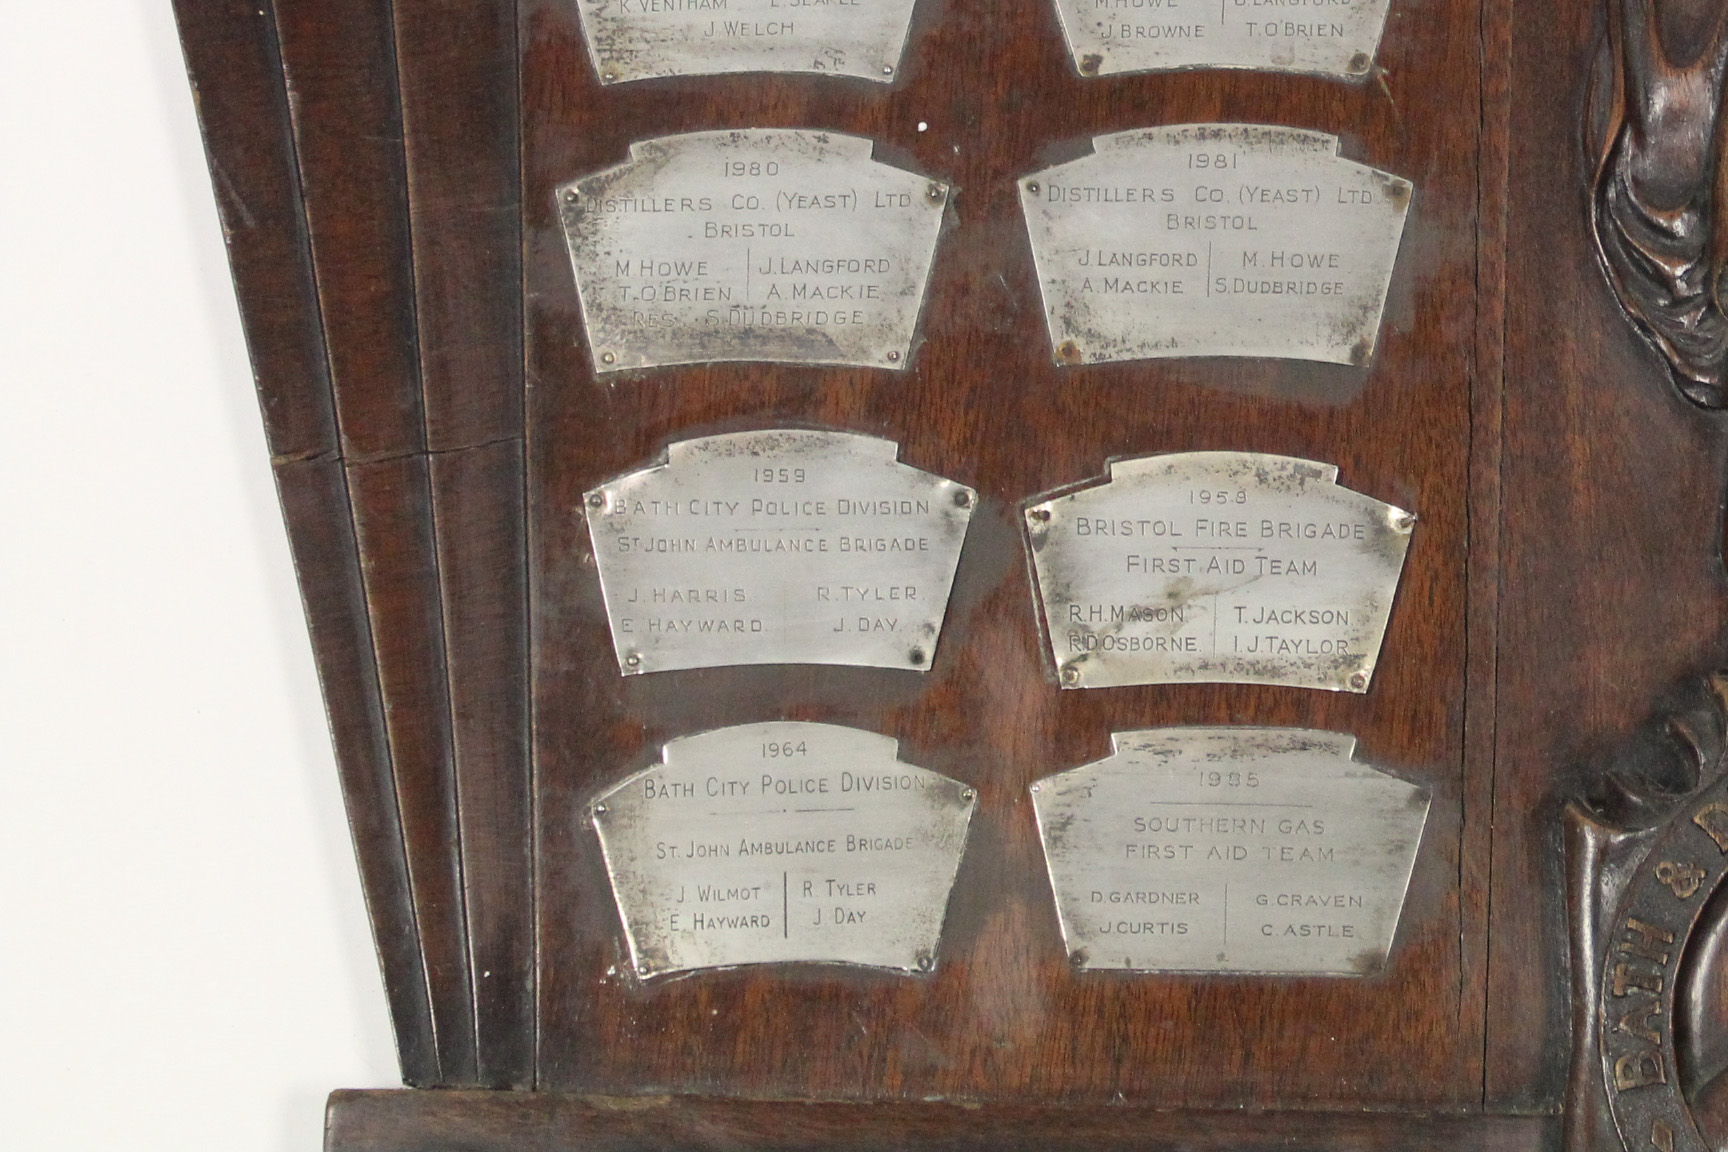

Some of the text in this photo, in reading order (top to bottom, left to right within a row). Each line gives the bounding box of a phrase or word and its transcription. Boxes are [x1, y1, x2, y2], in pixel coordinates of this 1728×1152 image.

[725, 161, 779, 178] 1980
[1188, 154, 1238, 169] 1981
[1048, 186, 1175, 203] DISTILLERS
[705, 223, 795, 238] BRISTOL
[1167, 214, 1257, 231] BRISTOL
[754, 469, 805, 483] 1959
[1190, 490, 1247, 505] 1958
[615, 499, 929, 516] BATH CITY POLICE DIVISION
[1077, 518, 1364, 539] BRISTOL FIRE BRIGADE
[1127, 555, 1317, 576] FIRST AID TEAM
[762, 742, 807, 758] 1964
[645, 772, 924, 799] BATH CITY POLICE DIVISION
[1134, 817, 1325, 835] SOUTHERN GAS
[687, 840, 729, 858] JOHN
[739, 839, 835, 856] AMBULANCE
[847, 834, 913, 852] BRIGADE
[1126, 844, 1334, 863] FIRST AID TEAM
[698, 885, 760, 903] WILMOT
[826, 879, 876, 897] TYLER
[694, 913, 771, 930] HAYWARD
[835, 907, 866, 924] DAY
[1611, 915, 1677, 1095] BATH
[1654, 860, 1708, 900] &
